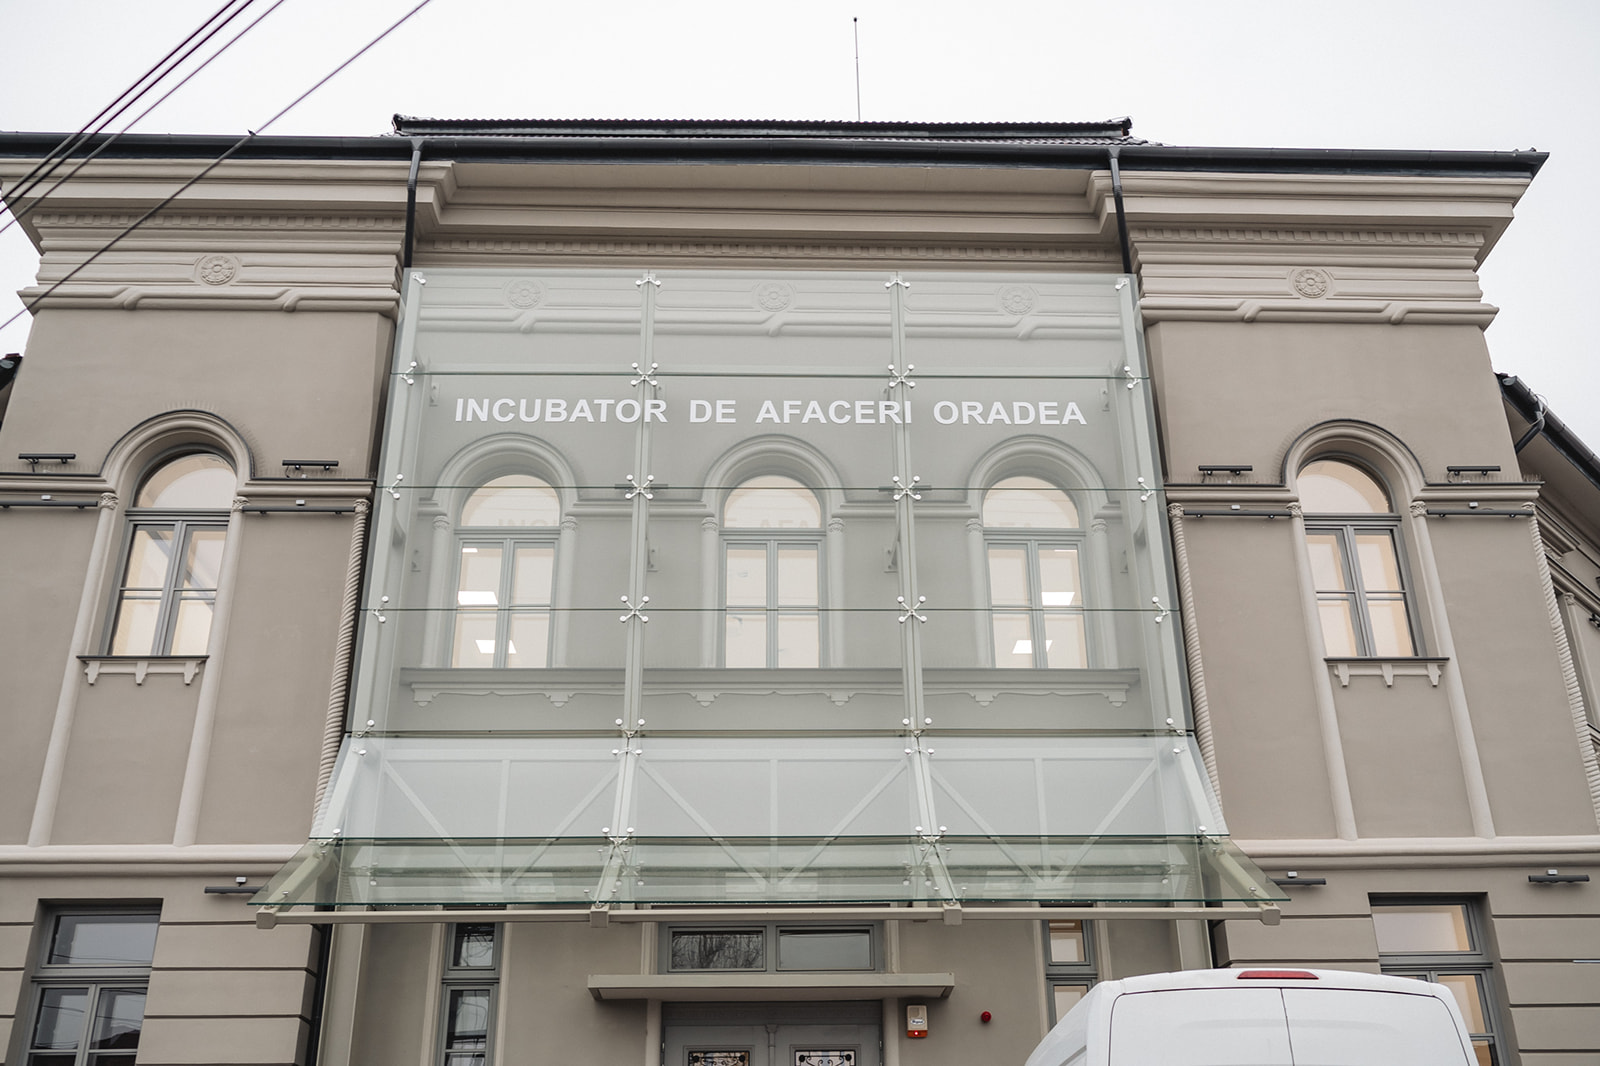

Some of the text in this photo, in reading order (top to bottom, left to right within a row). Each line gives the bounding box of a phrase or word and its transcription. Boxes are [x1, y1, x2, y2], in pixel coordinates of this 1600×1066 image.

[455, 398, 1087, 425] INCUBATOR DE AFACERI ORADEA
